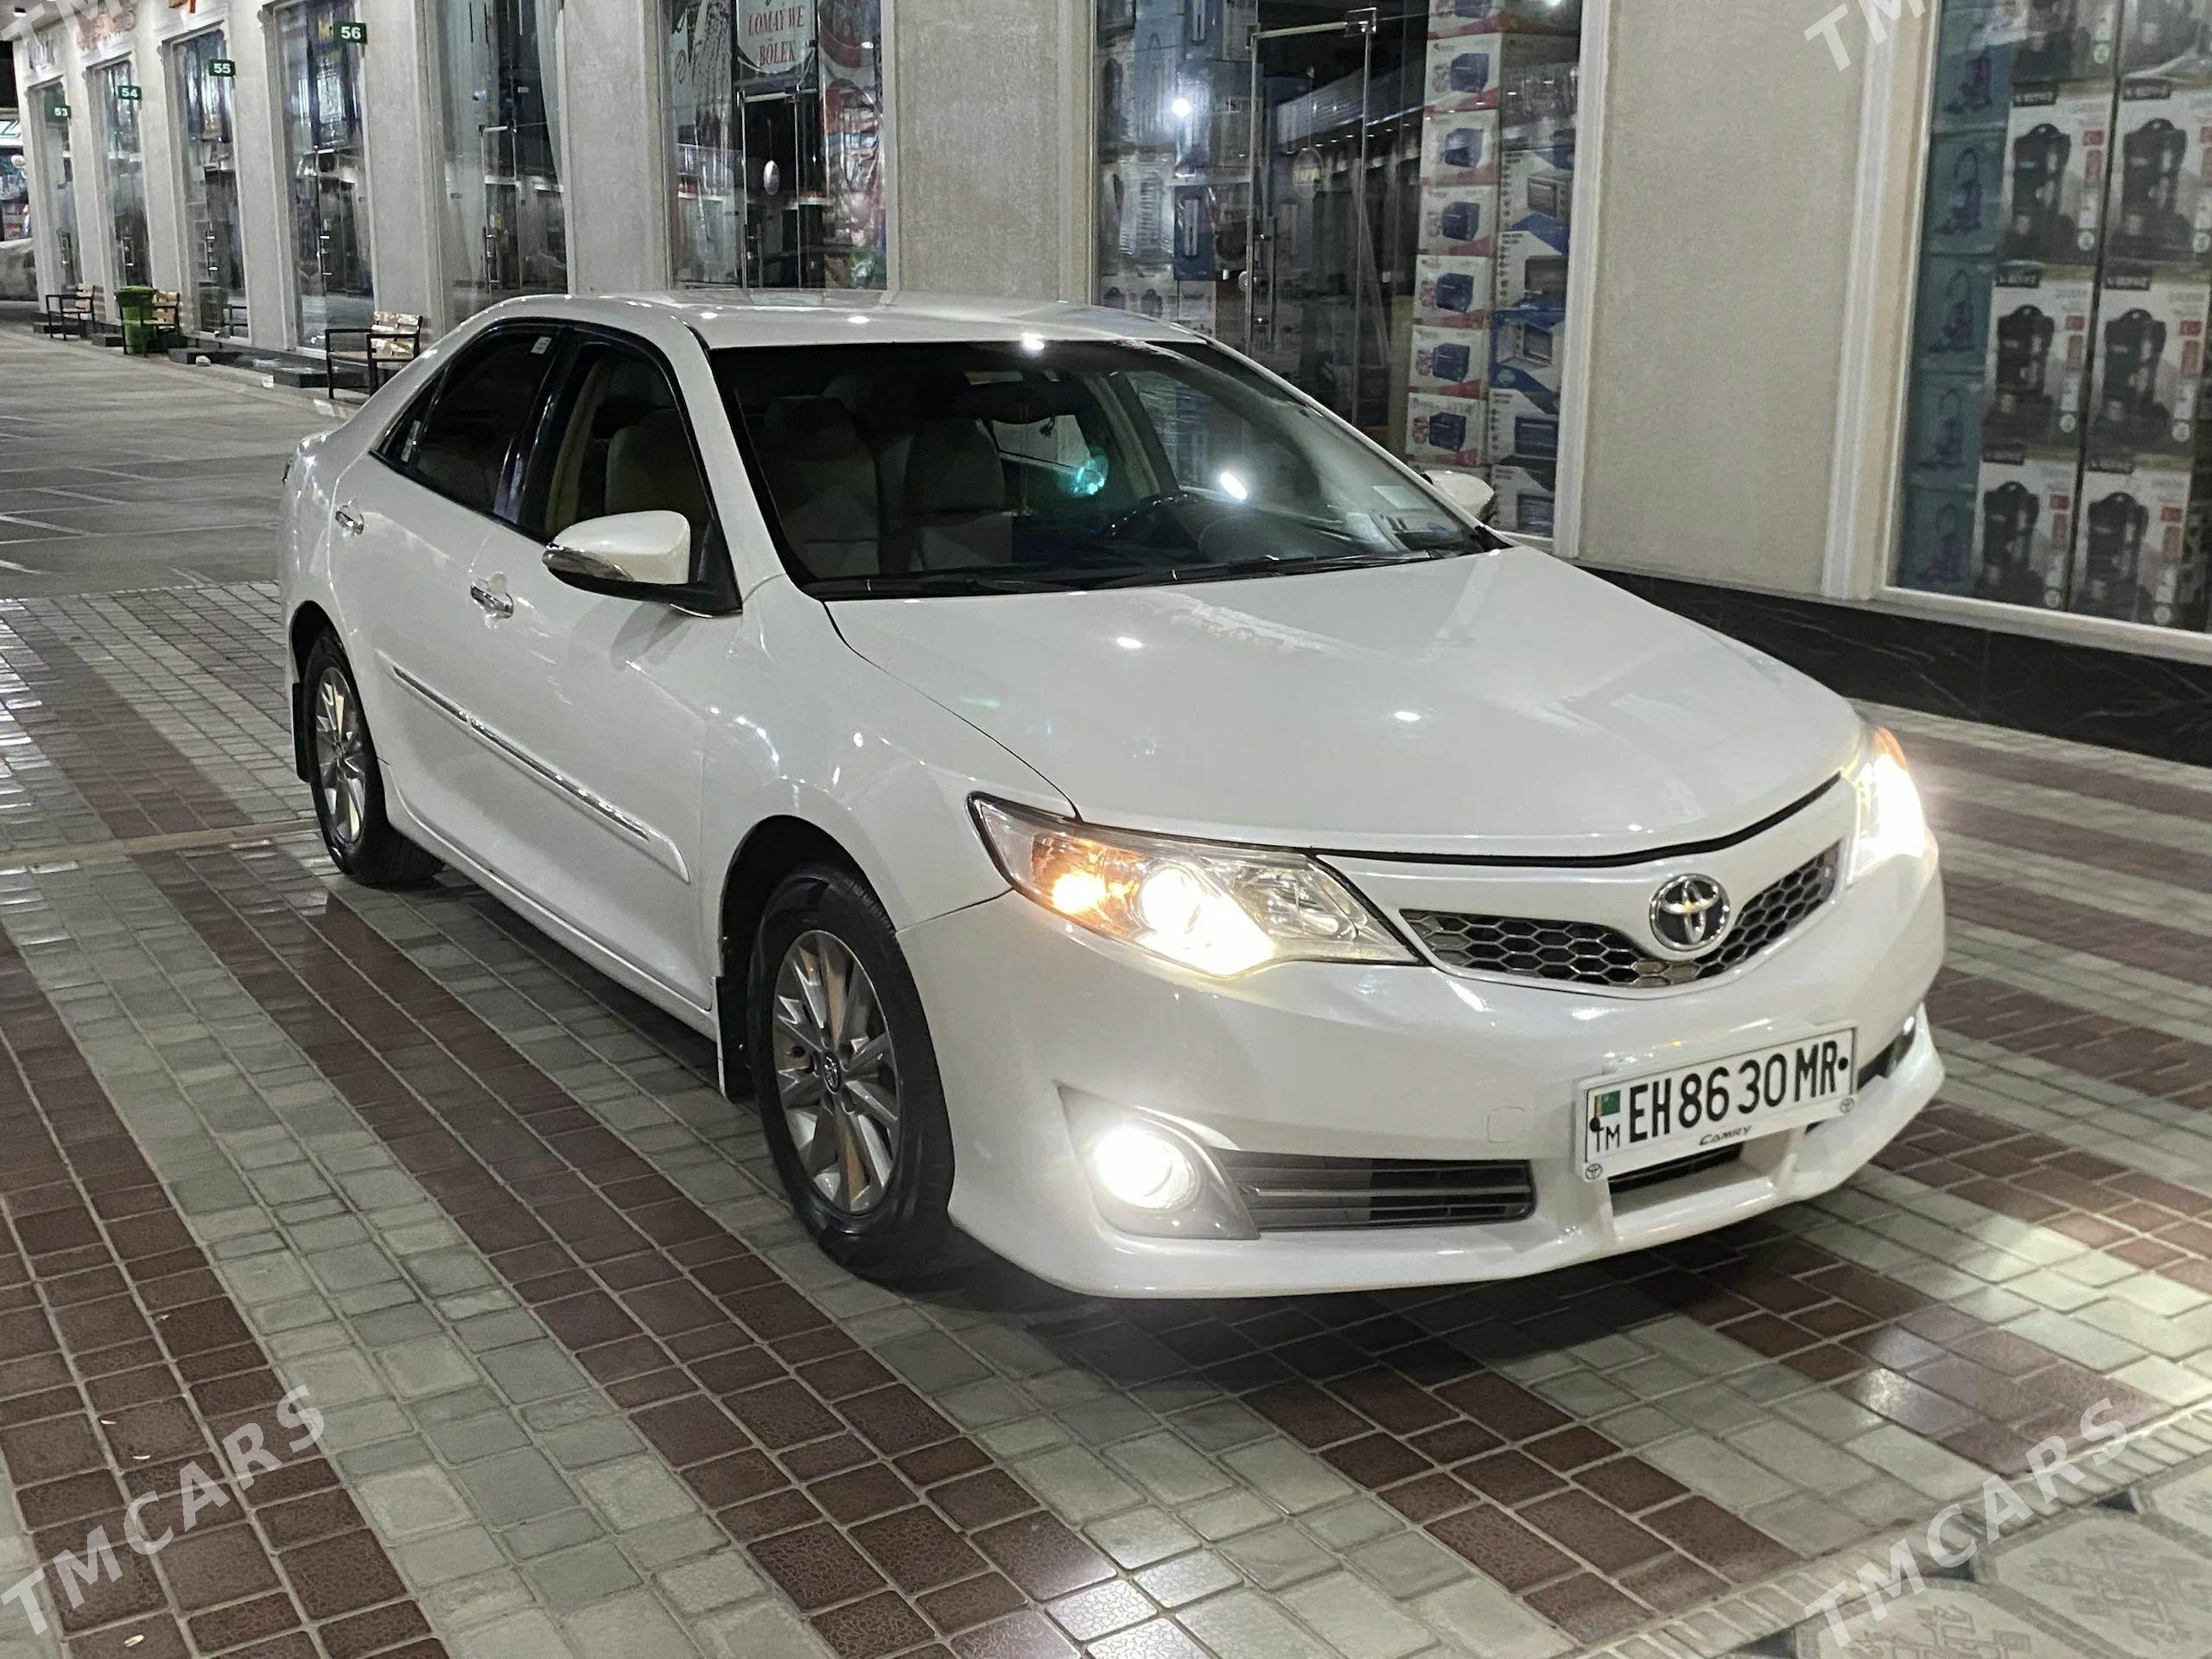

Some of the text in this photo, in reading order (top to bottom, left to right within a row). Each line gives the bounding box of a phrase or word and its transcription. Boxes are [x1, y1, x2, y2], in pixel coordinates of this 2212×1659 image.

[340, 26, 362, 40] 56
[213, 63, 232, 74] 55
[121, 88, 139, 98] 54
[54, 107, 68, 117] 53
[1591, 1123, 1621, 1154] TM
